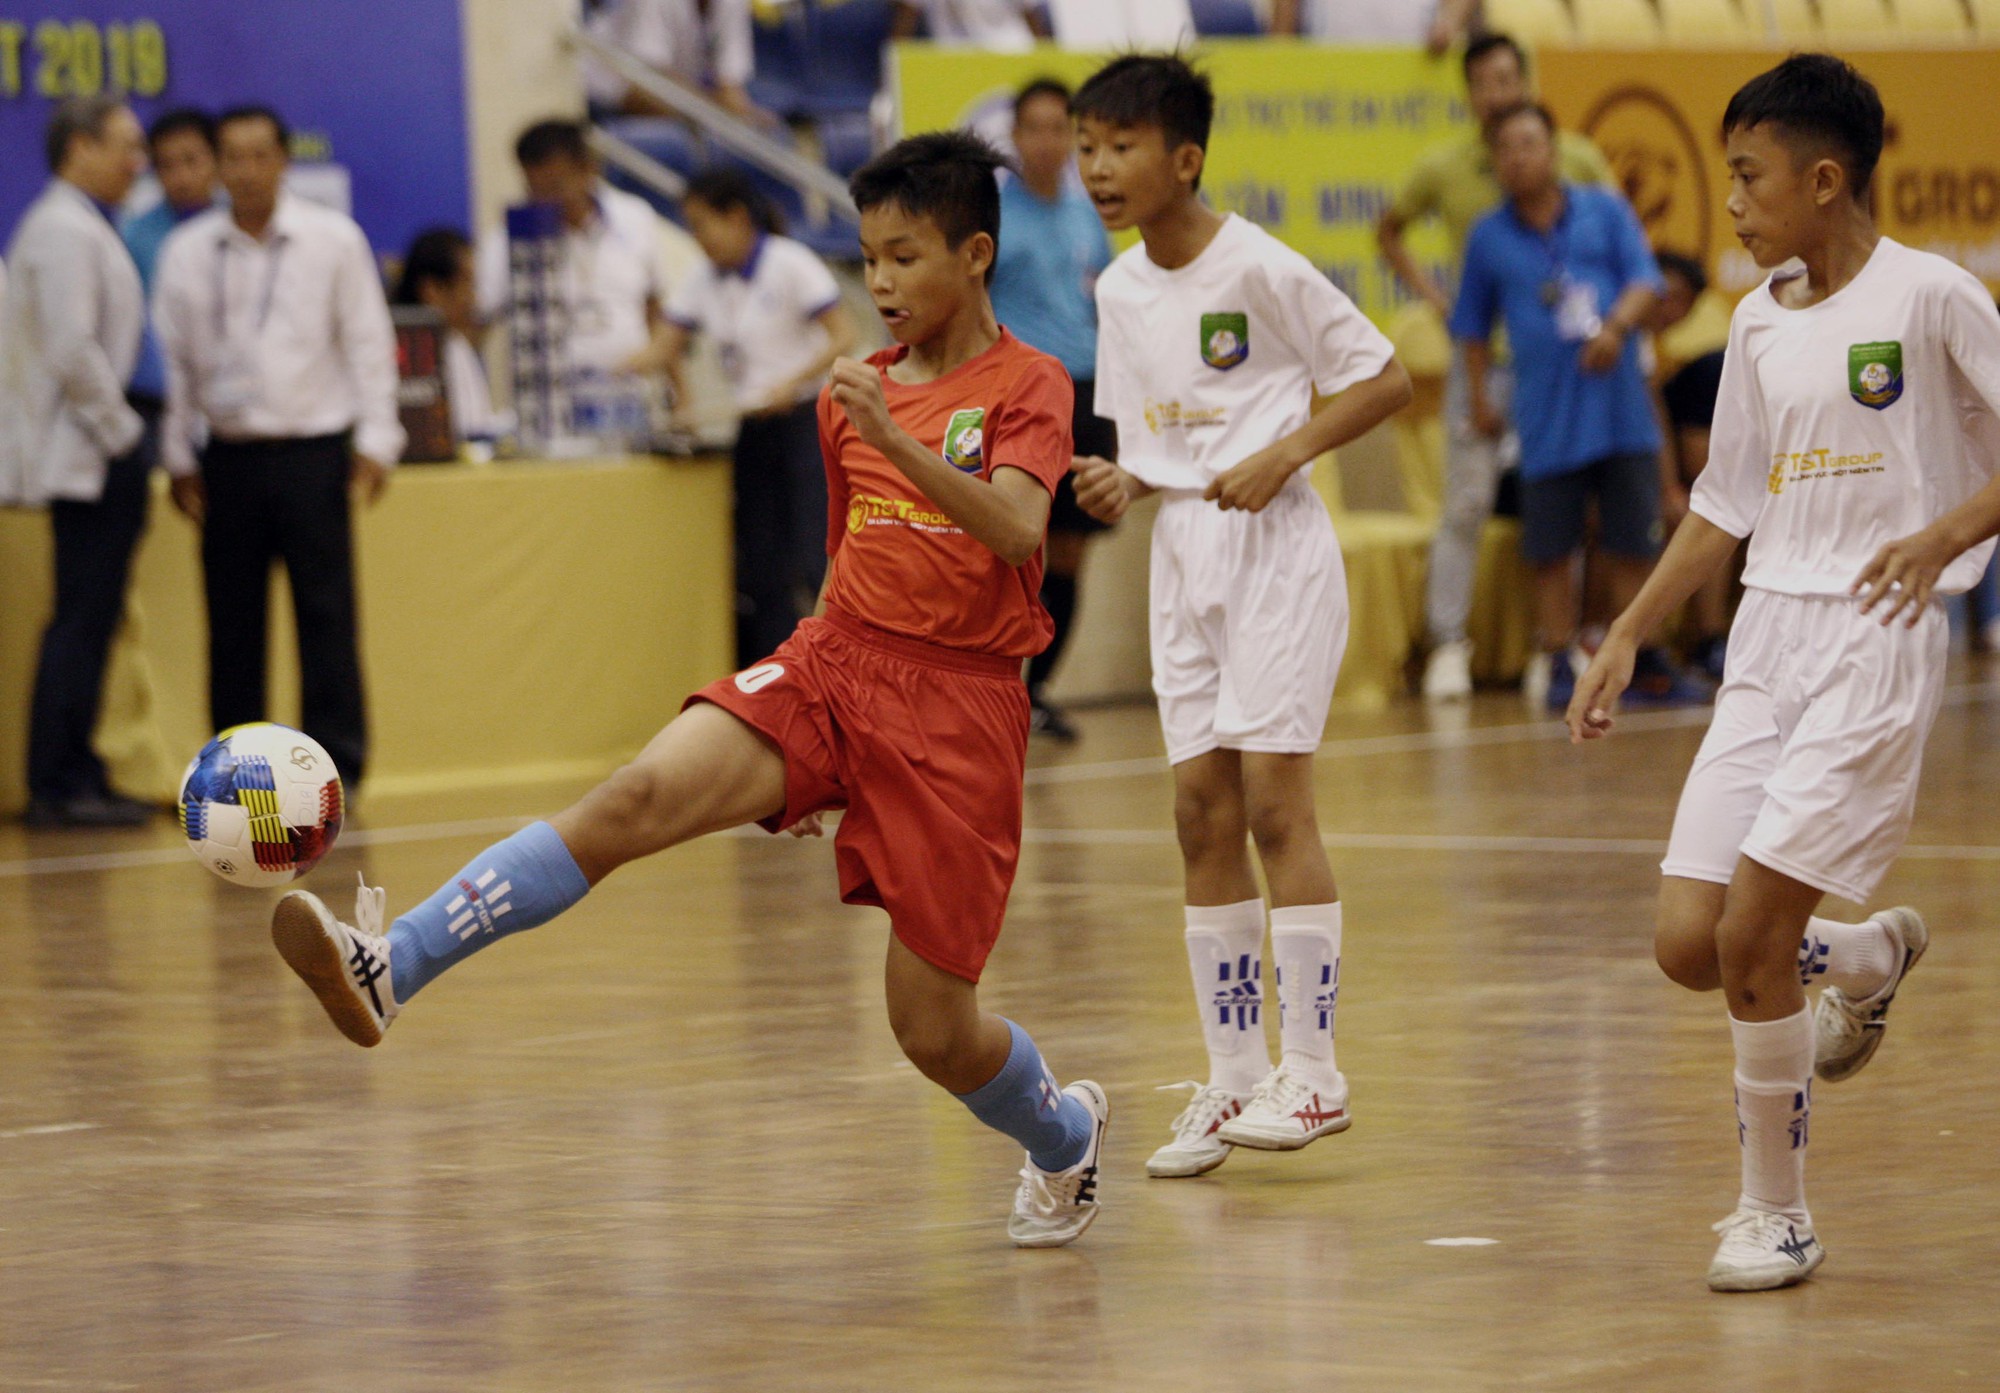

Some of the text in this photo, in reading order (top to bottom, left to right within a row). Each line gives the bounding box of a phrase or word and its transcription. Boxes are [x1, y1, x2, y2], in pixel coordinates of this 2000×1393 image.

[35, 19, 166, 97] 2019
[1829, 452, 1884, 468] GROUP
[909, 510, 952, 525] GROU
